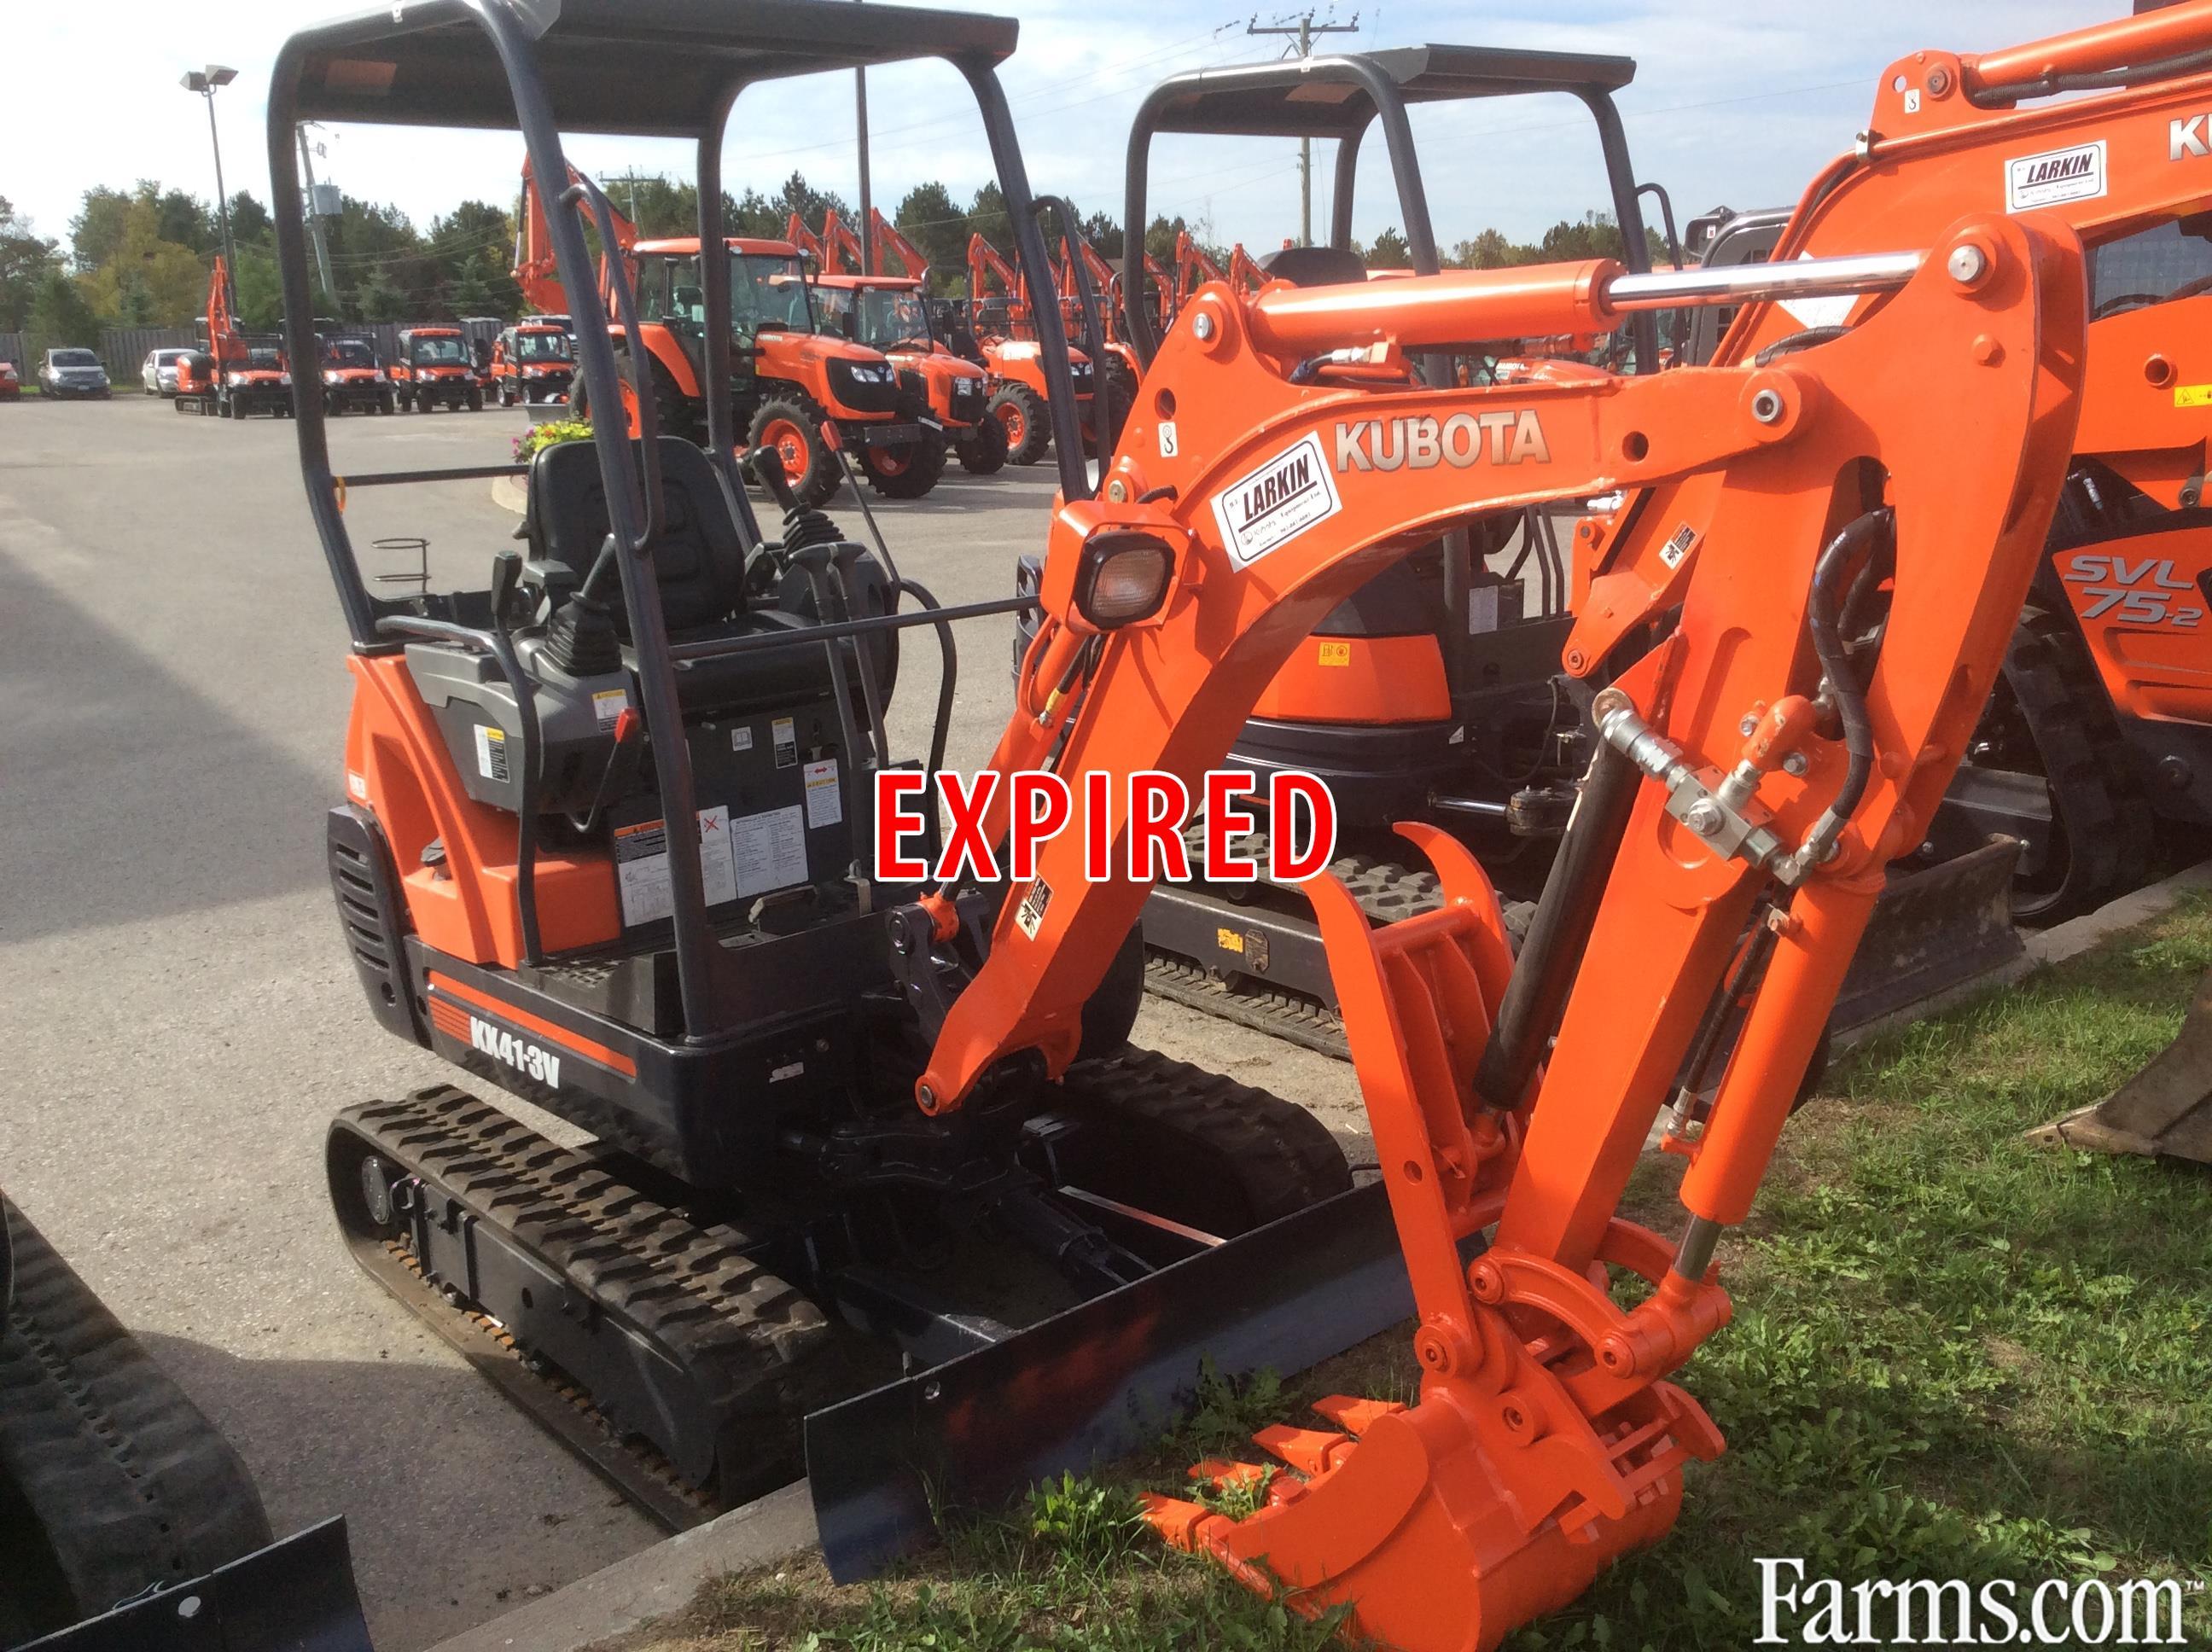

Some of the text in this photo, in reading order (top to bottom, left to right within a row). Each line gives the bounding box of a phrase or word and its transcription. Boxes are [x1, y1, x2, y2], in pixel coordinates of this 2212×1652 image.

[2168, 113, 2212, 161] K
[2027, 153, 2093, 183] LARKIN
[1335, 410, 1551, 473] KUBOTA
[1243, 453, 1309, 521] LARKIN
[2064, 555, 2194, 589] SVL
[2080, 586, 2203, 626] 75-2
[470, 1015, 560, 1089] KX41-3V
